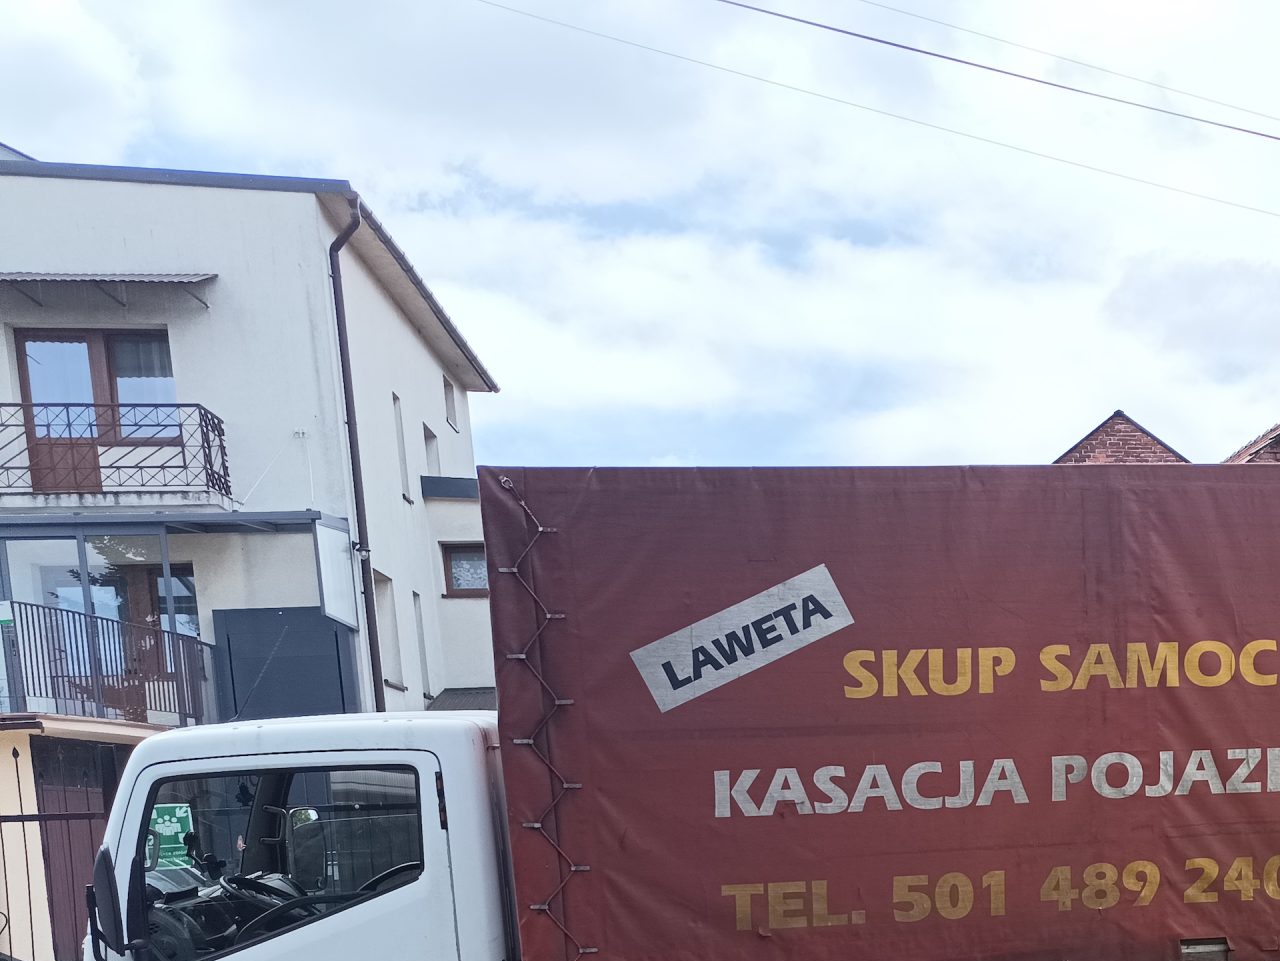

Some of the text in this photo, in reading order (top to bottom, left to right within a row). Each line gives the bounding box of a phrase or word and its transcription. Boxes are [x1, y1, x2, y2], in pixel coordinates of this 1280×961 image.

[661, 594, 833, 691] LAWETA
[842, 647, 1016, 699] SKUP
[713, 758, 1030, 818] KASACJA
[721, 879, 866, 931] TEL.
[892, 870, 1006, 923] 501
[1040, 859, 1161, 913] 489
